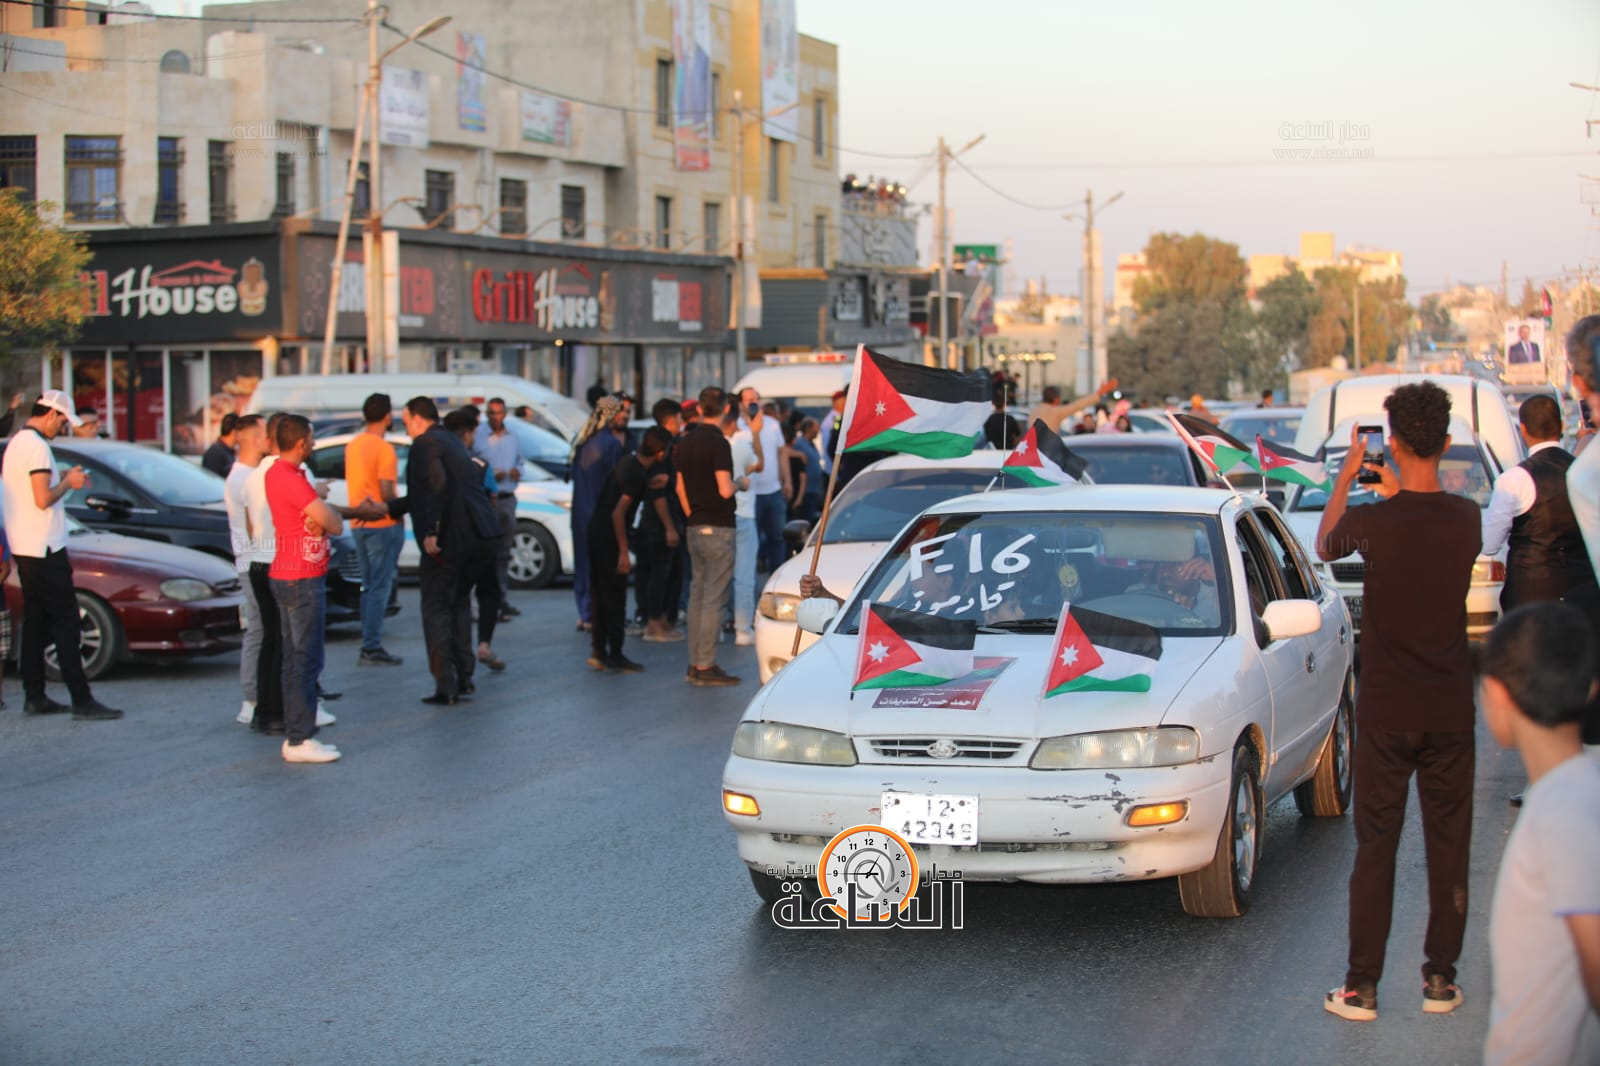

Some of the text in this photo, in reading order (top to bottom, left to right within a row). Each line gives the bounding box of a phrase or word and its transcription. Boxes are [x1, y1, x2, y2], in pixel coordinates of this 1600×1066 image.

[112, 265, 237, 319] House
[472, 268, 535, 323] Grill
[534, 268, 599, 333] House
[910, 532, 1036, 582] F-16
[927, 799, 951, 817] 12
